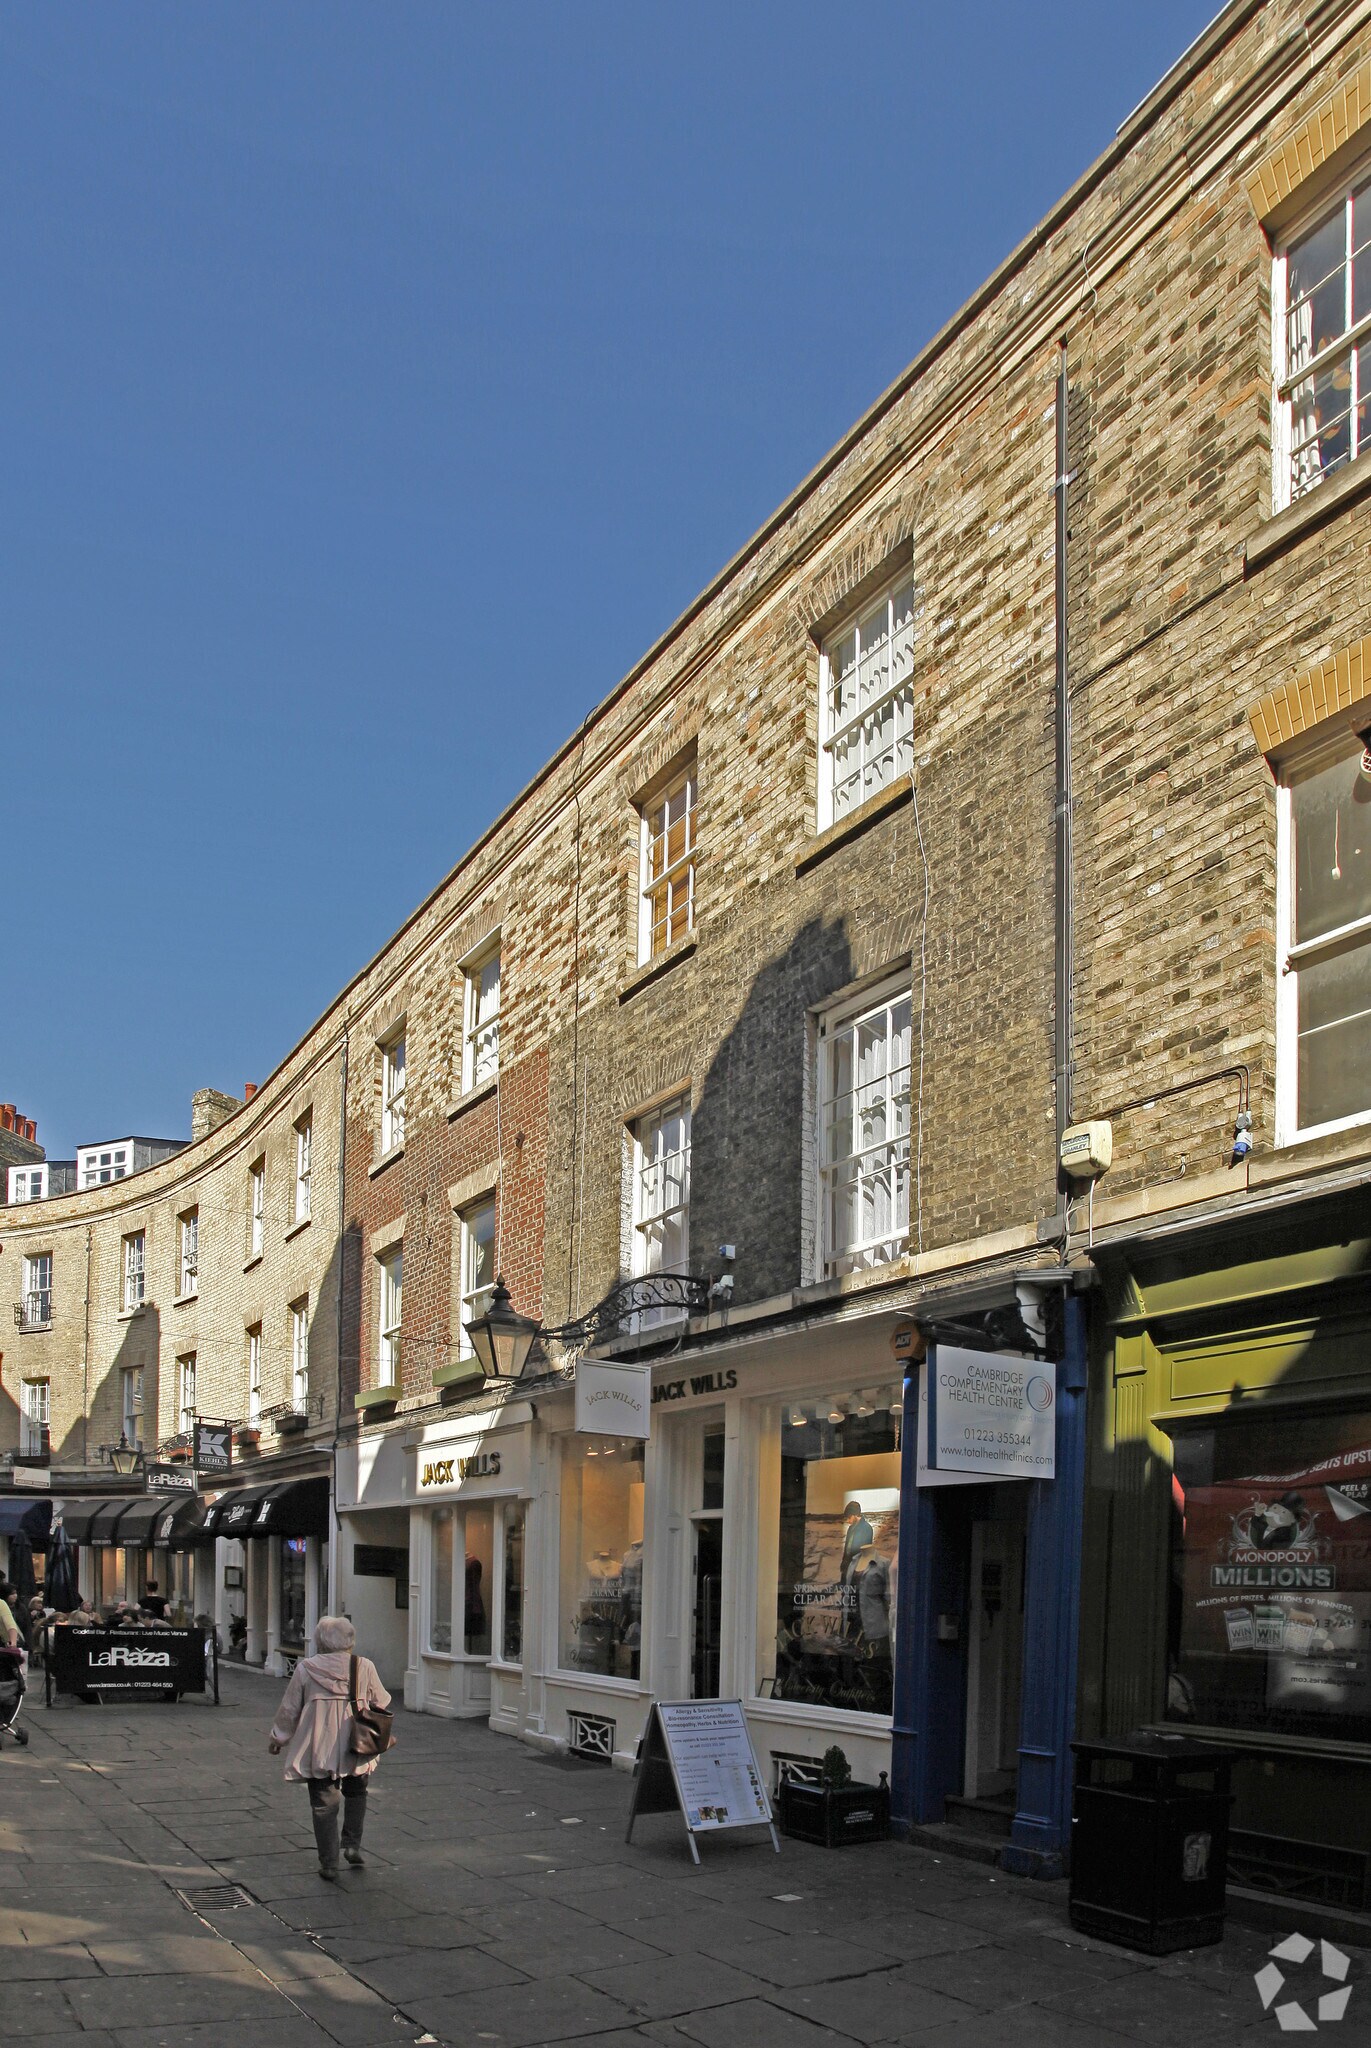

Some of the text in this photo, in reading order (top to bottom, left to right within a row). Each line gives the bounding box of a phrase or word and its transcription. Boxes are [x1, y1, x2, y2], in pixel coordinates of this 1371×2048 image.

[896, 1335, 911, 1345] ADT
[967, 1365, 1023, 1385] CAMBRIDGE
[651, 1369, 738, 1403] JACK WILLS
[940, 1374, 1023, 1396] COMPLEMENTARY
[585, 1390, 642, 1412] JACK WILLS
[949, 1388, 1023, 1410] HEALTH CENTRE
[964, 1427, 1031, 1446] 01223 355344
[199, 1456, 228, 1466] KIEHL'S
[941, 1445, 1053, 1465] www.totalhealthclinics.com
[421, 1451, 501, 1487] JACK WILLS
[1309, 1456, 1342, 1474] SEATS
[1339, 1484, 1359, 1492] PEEL
[1346, 1491, 1368, 1499] PLAY
[1235, 1551, 1312, 1563] MONOPOLY
[1214, 1566, 1331, 1587] MILLIONS
[794, 1584, 856, 1593] SPRING SEASON
[793, 1594, 857, 1607] CLEARANCE
[1196, 1598, 1228, 1608] MILLIONS
[1240, 1594, 1266, 1602] PRIZES.
[1267, 1595, 1303, 1604] MILLIONS
[1316, 1599, 1355, 1613] WINNERS.
[1231, 1628, 1252, 1638] WIN
[1258, 1629, 1281, 1639] WIN
